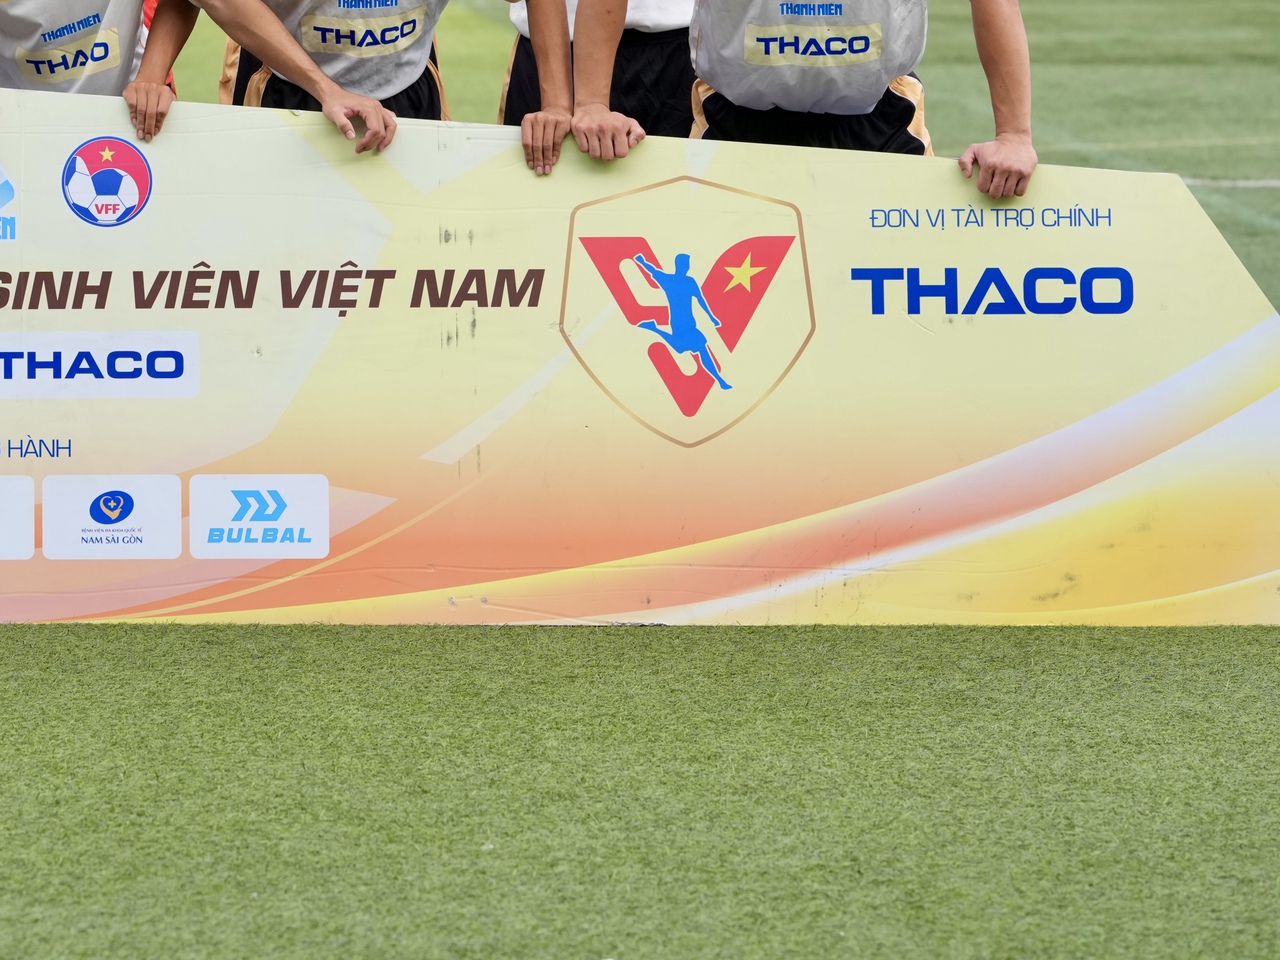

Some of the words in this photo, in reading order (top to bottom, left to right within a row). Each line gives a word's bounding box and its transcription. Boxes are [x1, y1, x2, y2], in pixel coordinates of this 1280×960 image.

[779, 3, 816, 16] THANH
[41, 22, 77, 43] THANH
[313, 18, 417, 48] THACO
[756, 35, 870, 56] THACO
[94, 203, 120, 215] VFF
[869, 208, 920, 227] ĐƠN
[926, 209, 945, 230] VỊ
[951, 204, 985, 227] TÀI
[990, 207, 1035, 230] TRỢ
[1041, 203, 1112, 227] CHÍNH
[132, 261, 260, 309] VIÊN
[279, 260, 397, 318] VIỆT
[409, 269, 546, 308] NAM
[851, 267, 1134, 315] THACO
[7, 434, 72, 458] HÀNH
[81, 536, 103, 544] NAM
[105, 534, 120, 544] SÀI
[122, 533, 143, 544] GÒN
[206, 527, 312, 543] BULBAL
